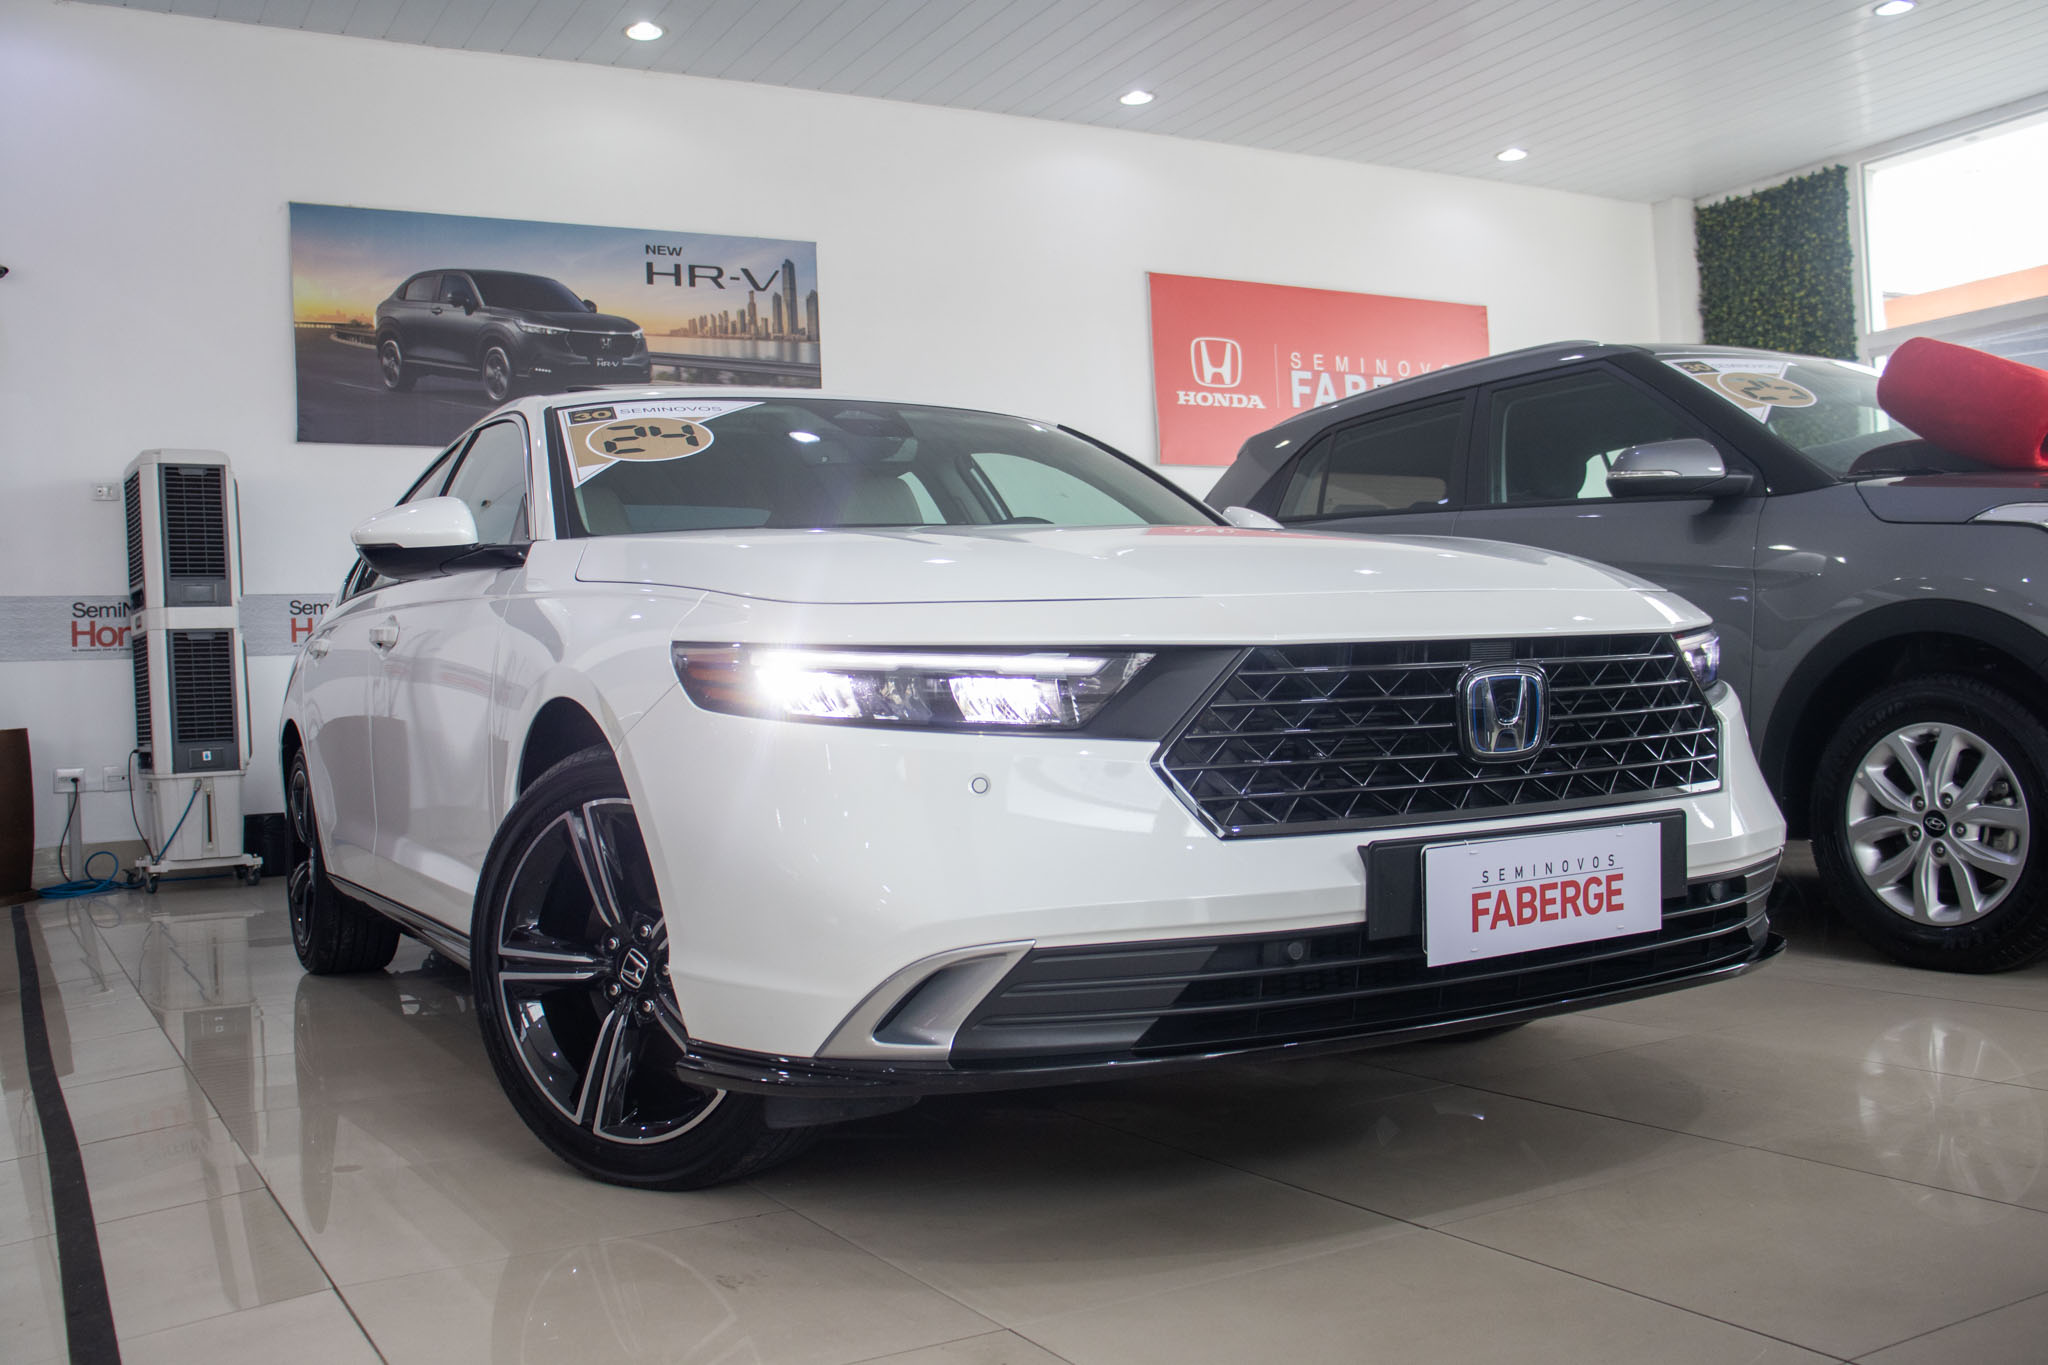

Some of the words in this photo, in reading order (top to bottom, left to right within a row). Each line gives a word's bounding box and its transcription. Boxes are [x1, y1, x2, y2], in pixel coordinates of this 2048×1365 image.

[645, 244, 683, 256] NEW
[646, 261, 780, 292] HR-V
[1290, 352, 1451, 376] SEMINOV
[1176, 390, 1267, 409] HONDA
[573, 410, 612, 422] 30
[620, 406, 722, 415] SEMINOVOS
[603, 424, 699, 455] 24
[1482, 854, 1615, 883] SEMINOVOS
[1472, 873, 1624, 933] FABERGE
